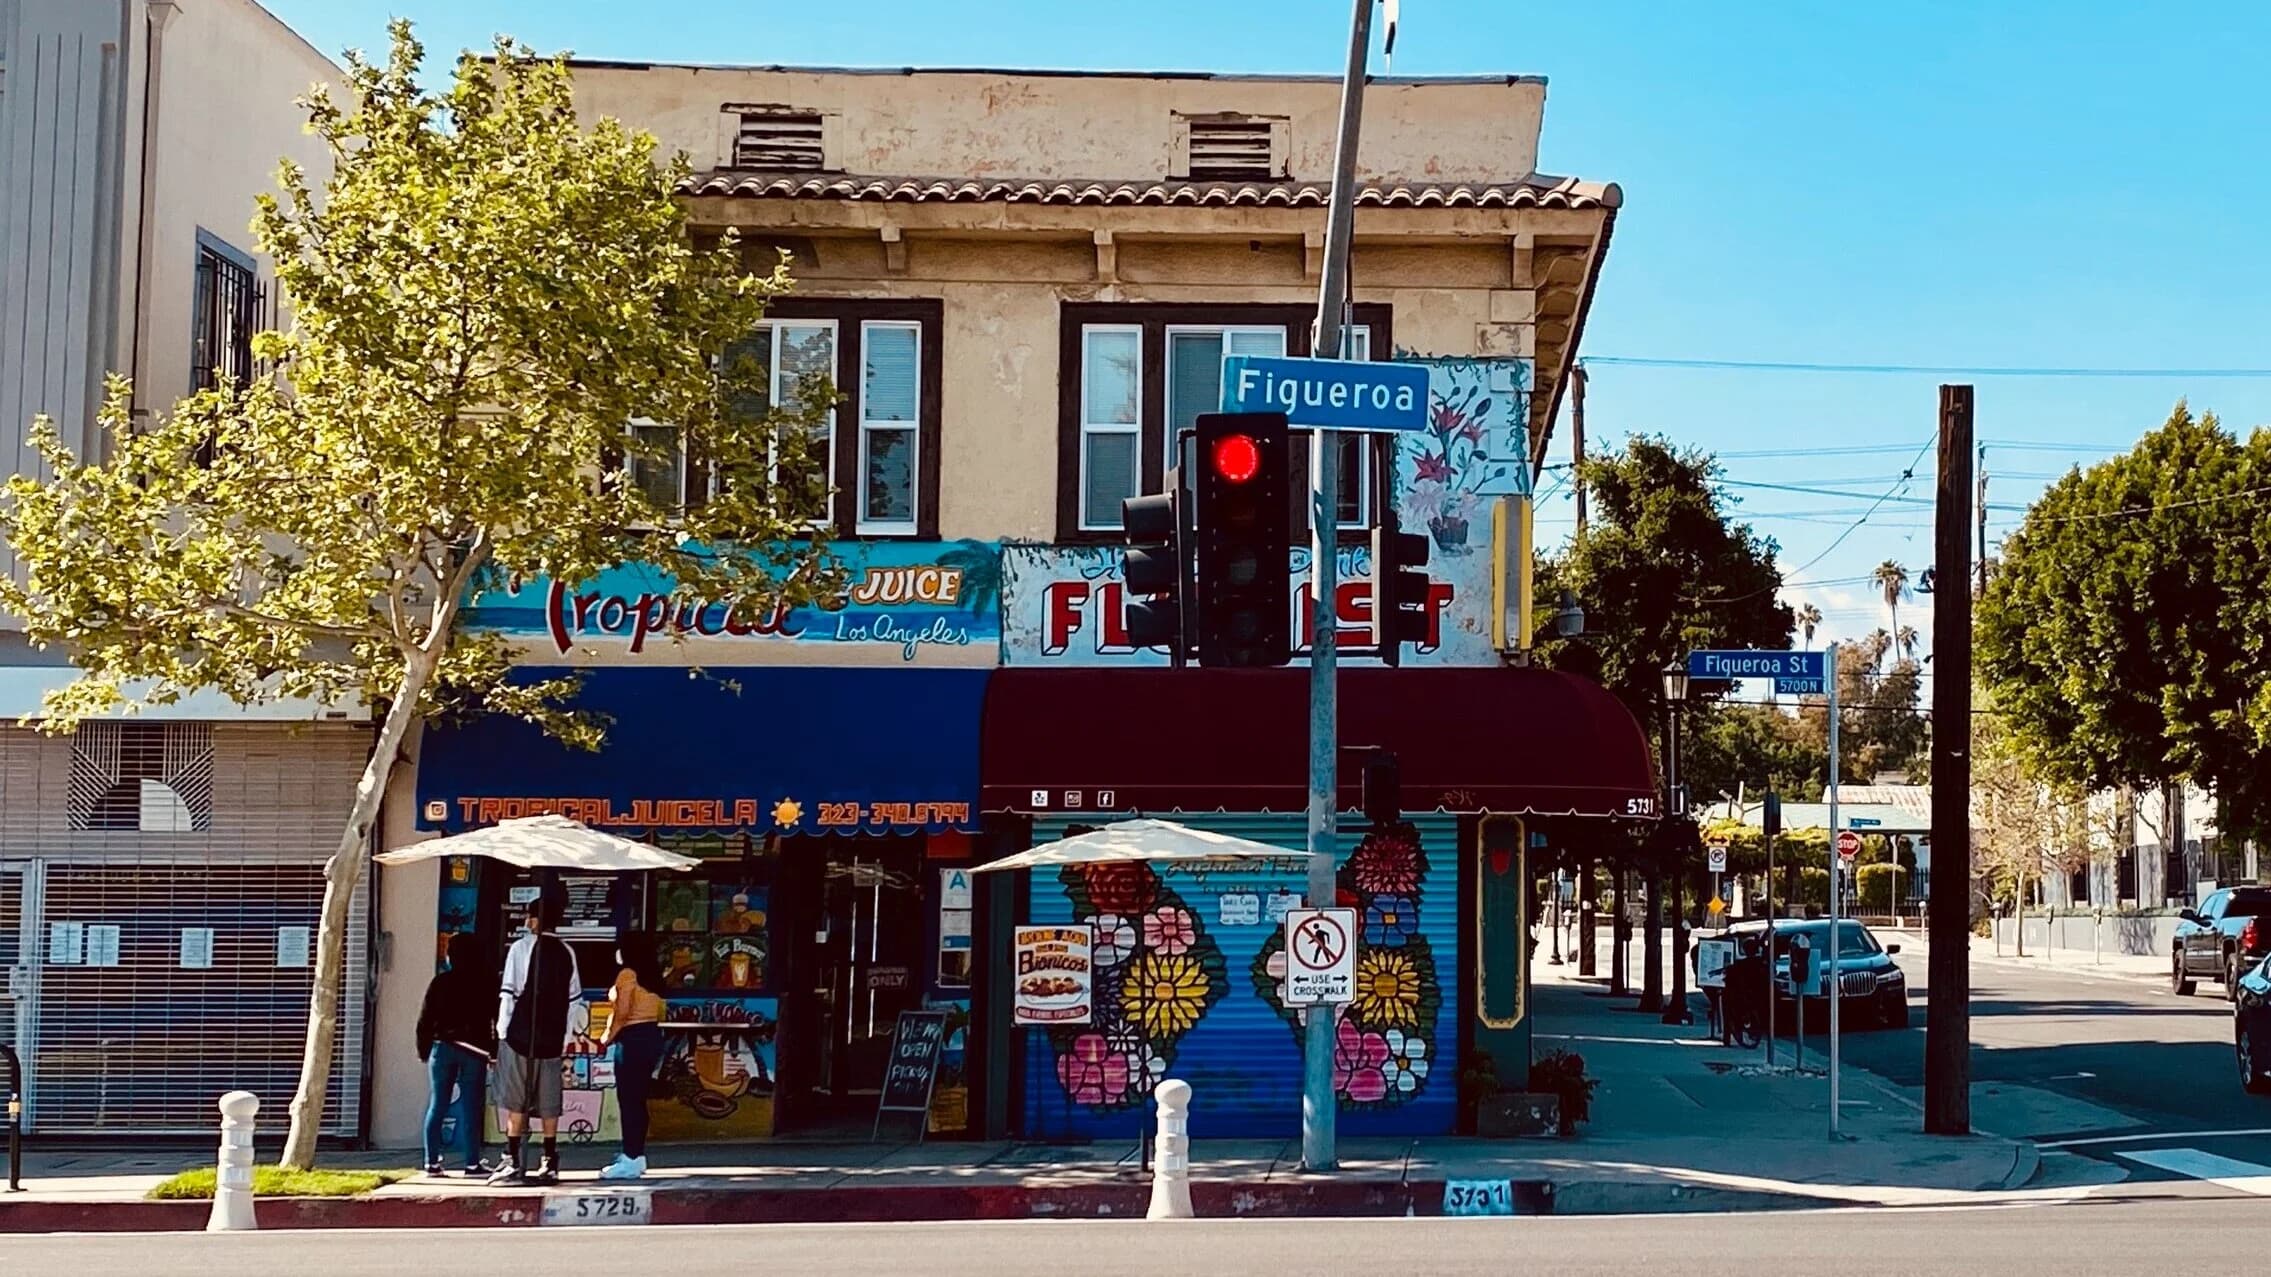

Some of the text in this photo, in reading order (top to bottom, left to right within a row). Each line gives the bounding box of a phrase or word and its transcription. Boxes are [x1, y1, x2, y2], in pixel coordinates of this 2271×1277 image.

[1238, 368, 1414, 415] Figueroa
[857, 568, 961, 602] JUICE
[1041, 582, 1454, 655] FLIST
[836, 613, 969, 660] Los Angeles
[1705, 655, 1808, 676] Figueroa St
[1780, 680, 1817, 692] 5700 N
[1627, 798, 1654, 814] 5731
[1839, 839, 1858, 850] STOP
[949, 871, 967, 890] A
[870, 976, 906, 987] ONLY
[1311, 975, 1331, 984] USE
[1294, 986, 1348, 995] CROSSWALK
[576, 1197, 635, 1217] 5729
